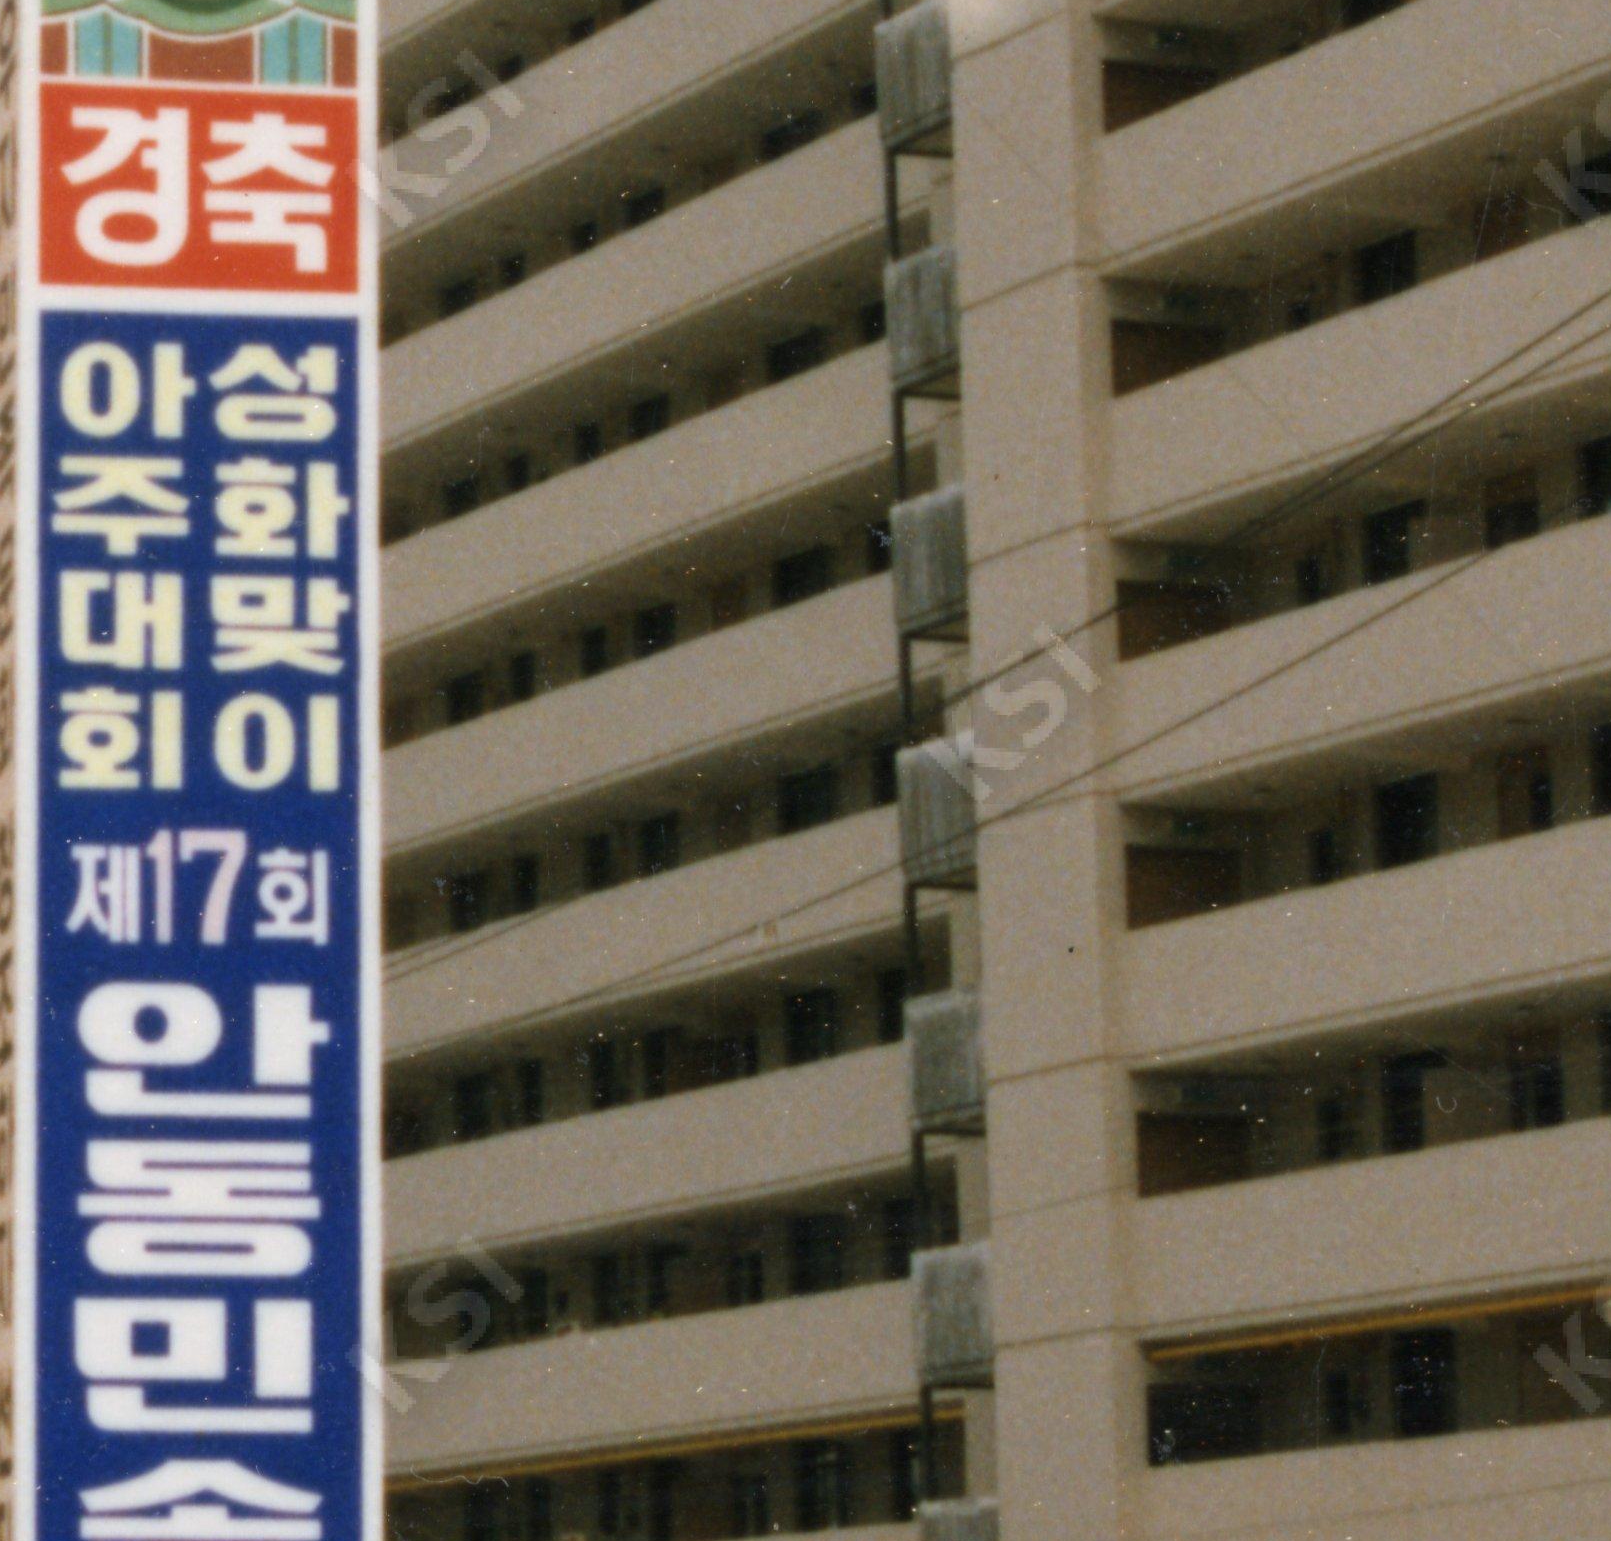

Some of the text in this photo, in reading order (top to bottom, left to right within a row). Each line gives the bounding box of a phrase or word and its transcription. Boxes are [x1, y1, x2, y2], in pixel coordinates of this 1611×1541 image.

[60, 106, 336, 274] 경축
[52, 342, 196, 791] 아주대회
[209, 344, 350, 793] 성화맞이
[66, 830, 330, 946] 제17회
